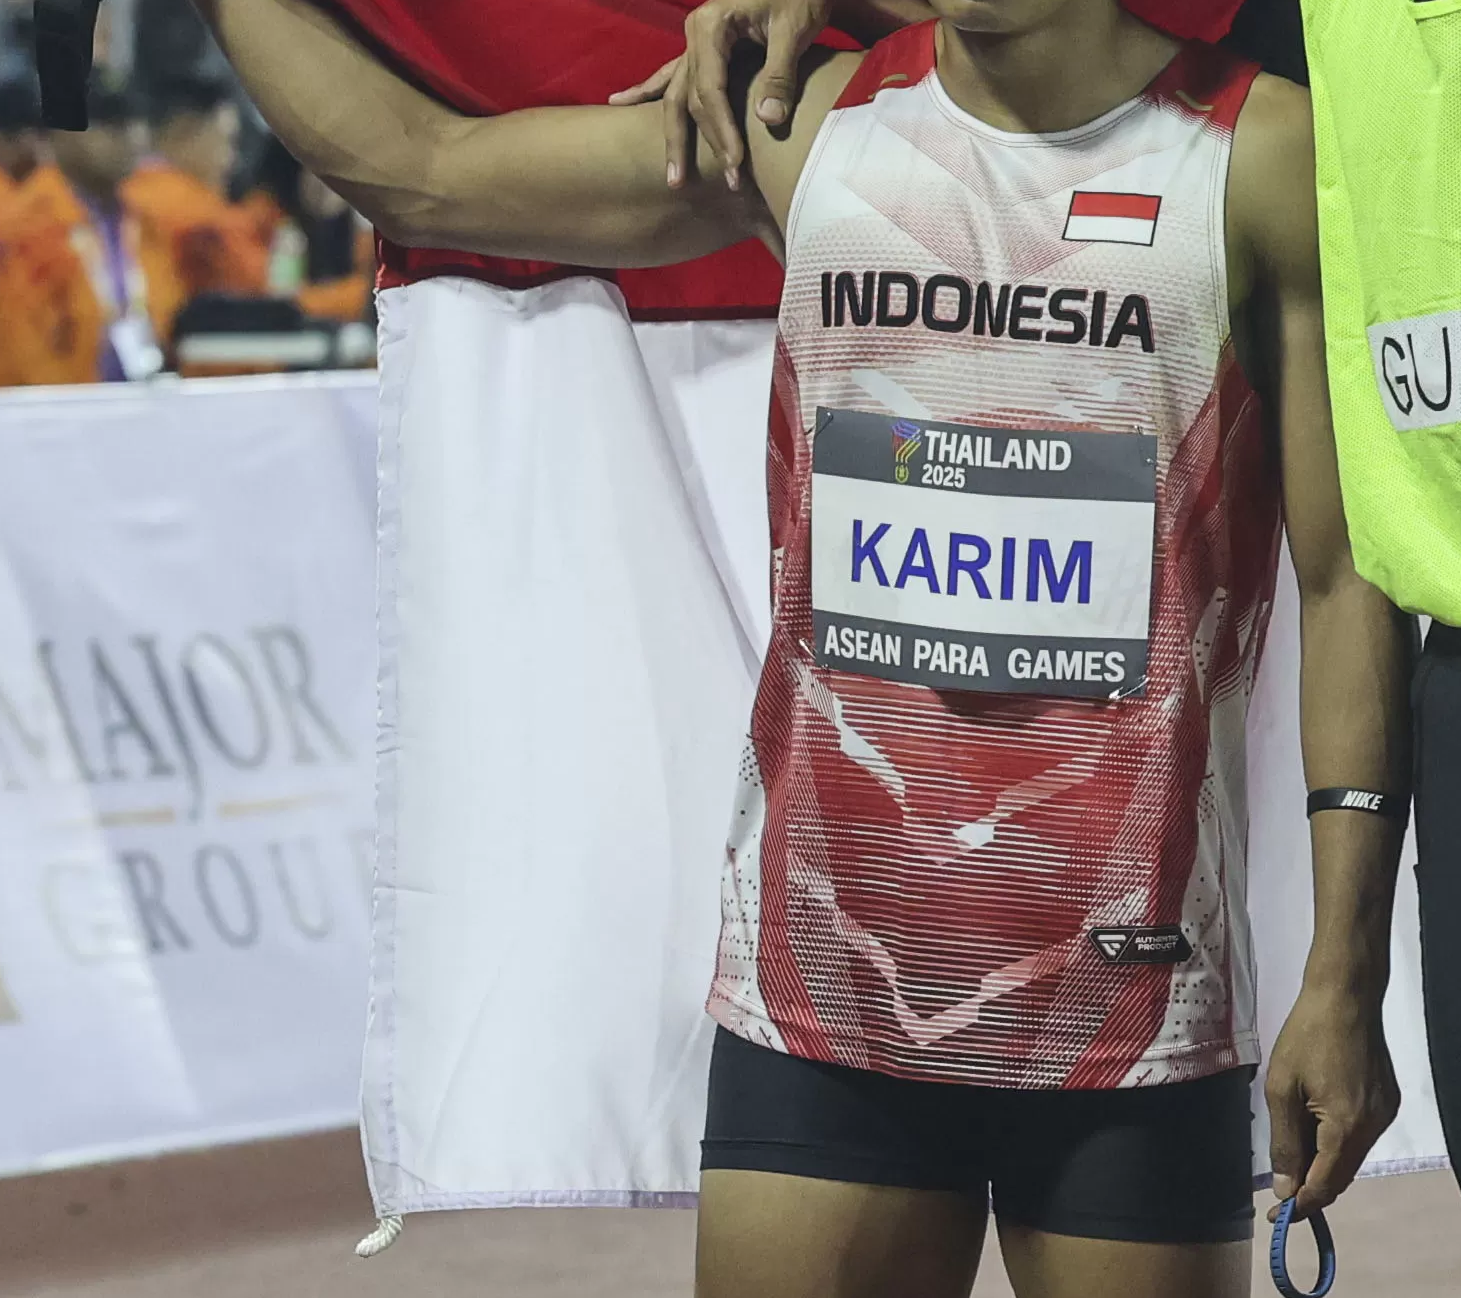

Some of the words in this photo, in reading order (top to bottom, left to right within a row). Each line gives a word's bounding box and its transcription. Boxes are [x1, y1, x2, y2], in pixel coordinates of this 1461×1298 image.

[821, 270, 1155, 353] INDONESIA
[924, 429, 1073, 472] THAILAND
[921, 464, 966, 490] 2025
[851, 518, 1093, 604] KARIM
[824, 625, 902, 667] ASEAN
[913, 637, 990, 678] PARA
[1007, 648, 1126, 683] GAMES
[1341, 790, 1384, 811] NIKE
[1137, 941, 1177, 951] PRODUCT
